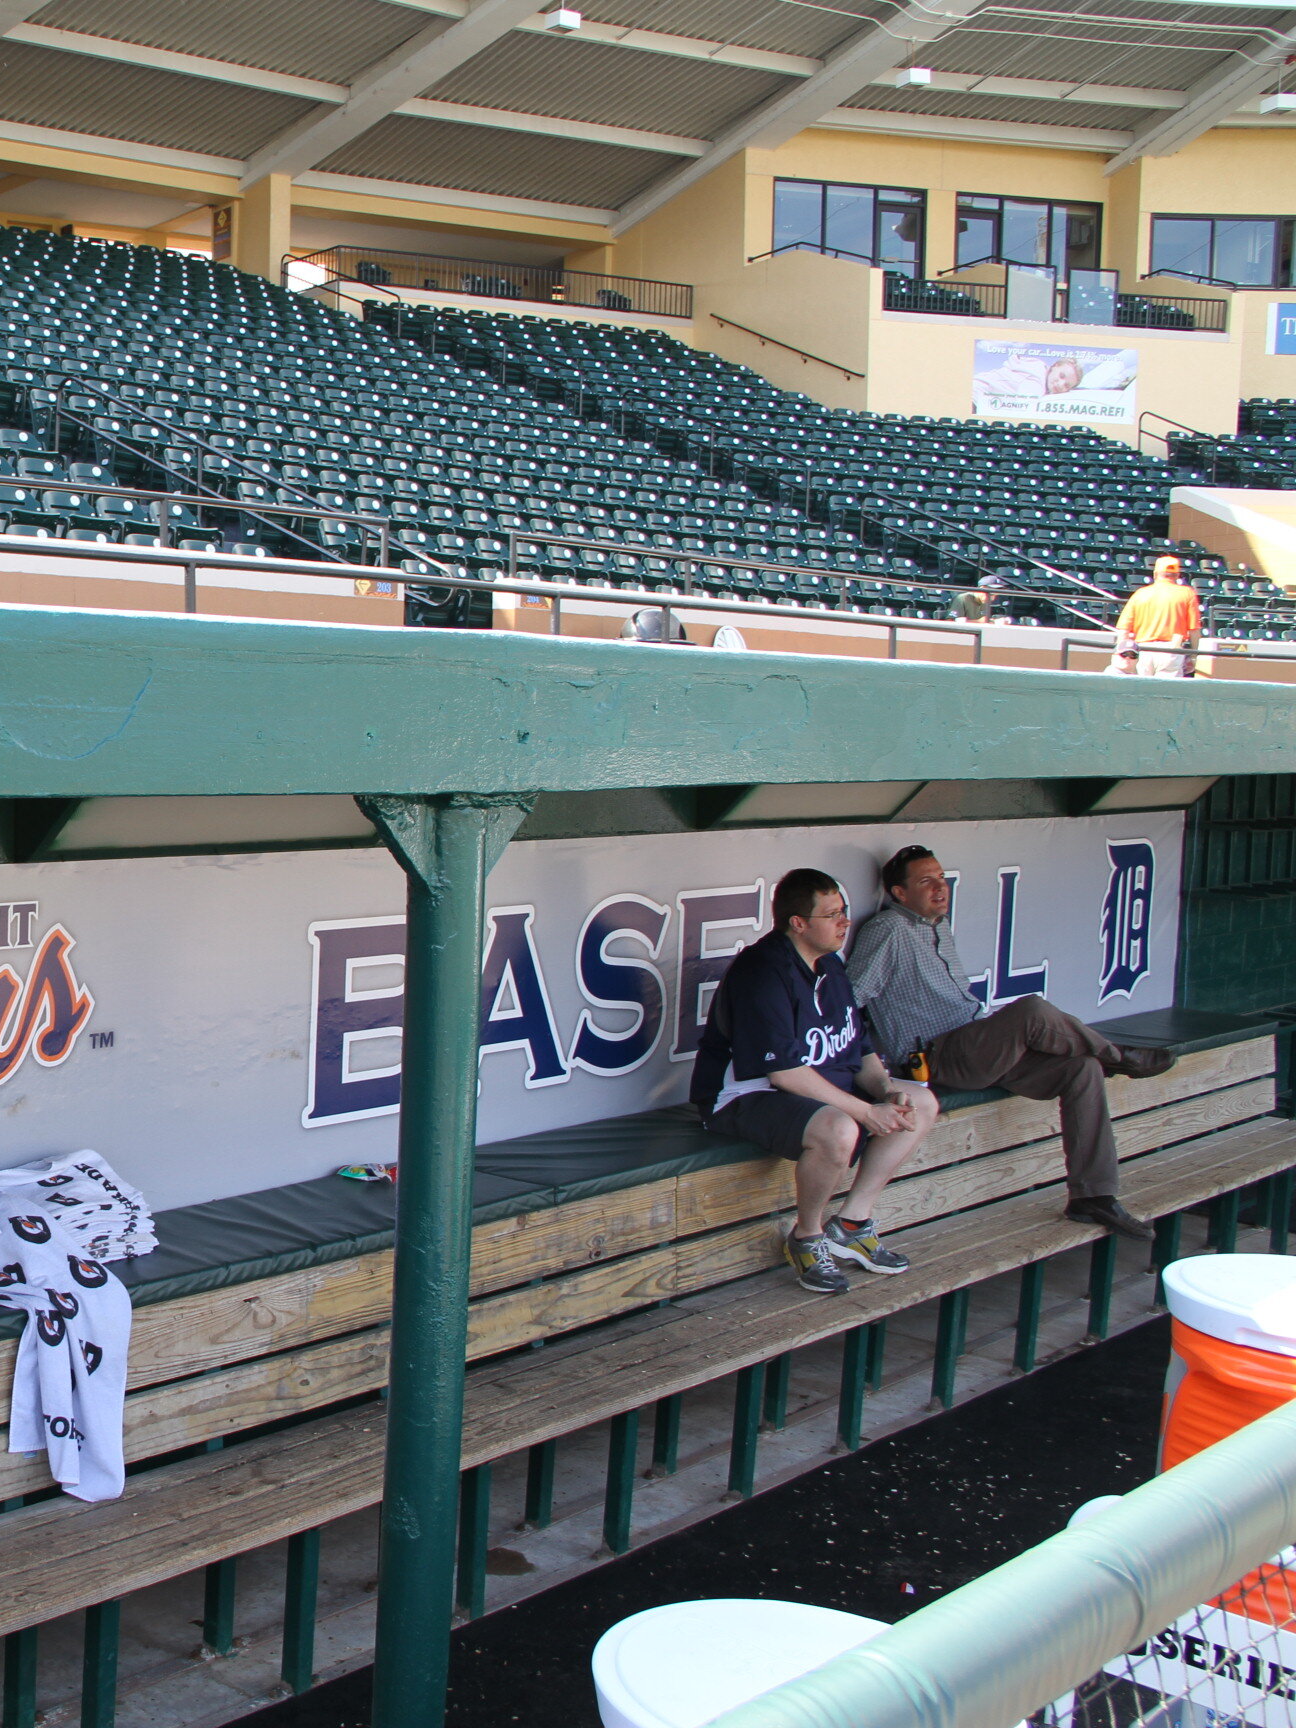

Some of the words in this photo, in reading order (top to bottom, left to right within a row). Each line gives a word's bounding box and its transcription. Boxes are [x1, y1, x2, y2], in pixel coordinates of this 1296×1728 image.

[987, 345, 1006, 354] Love
[1007, 346, 1026, 356] your
[377, 582, 392, 593] 203
[90, 1031, 115, 1049] TM
